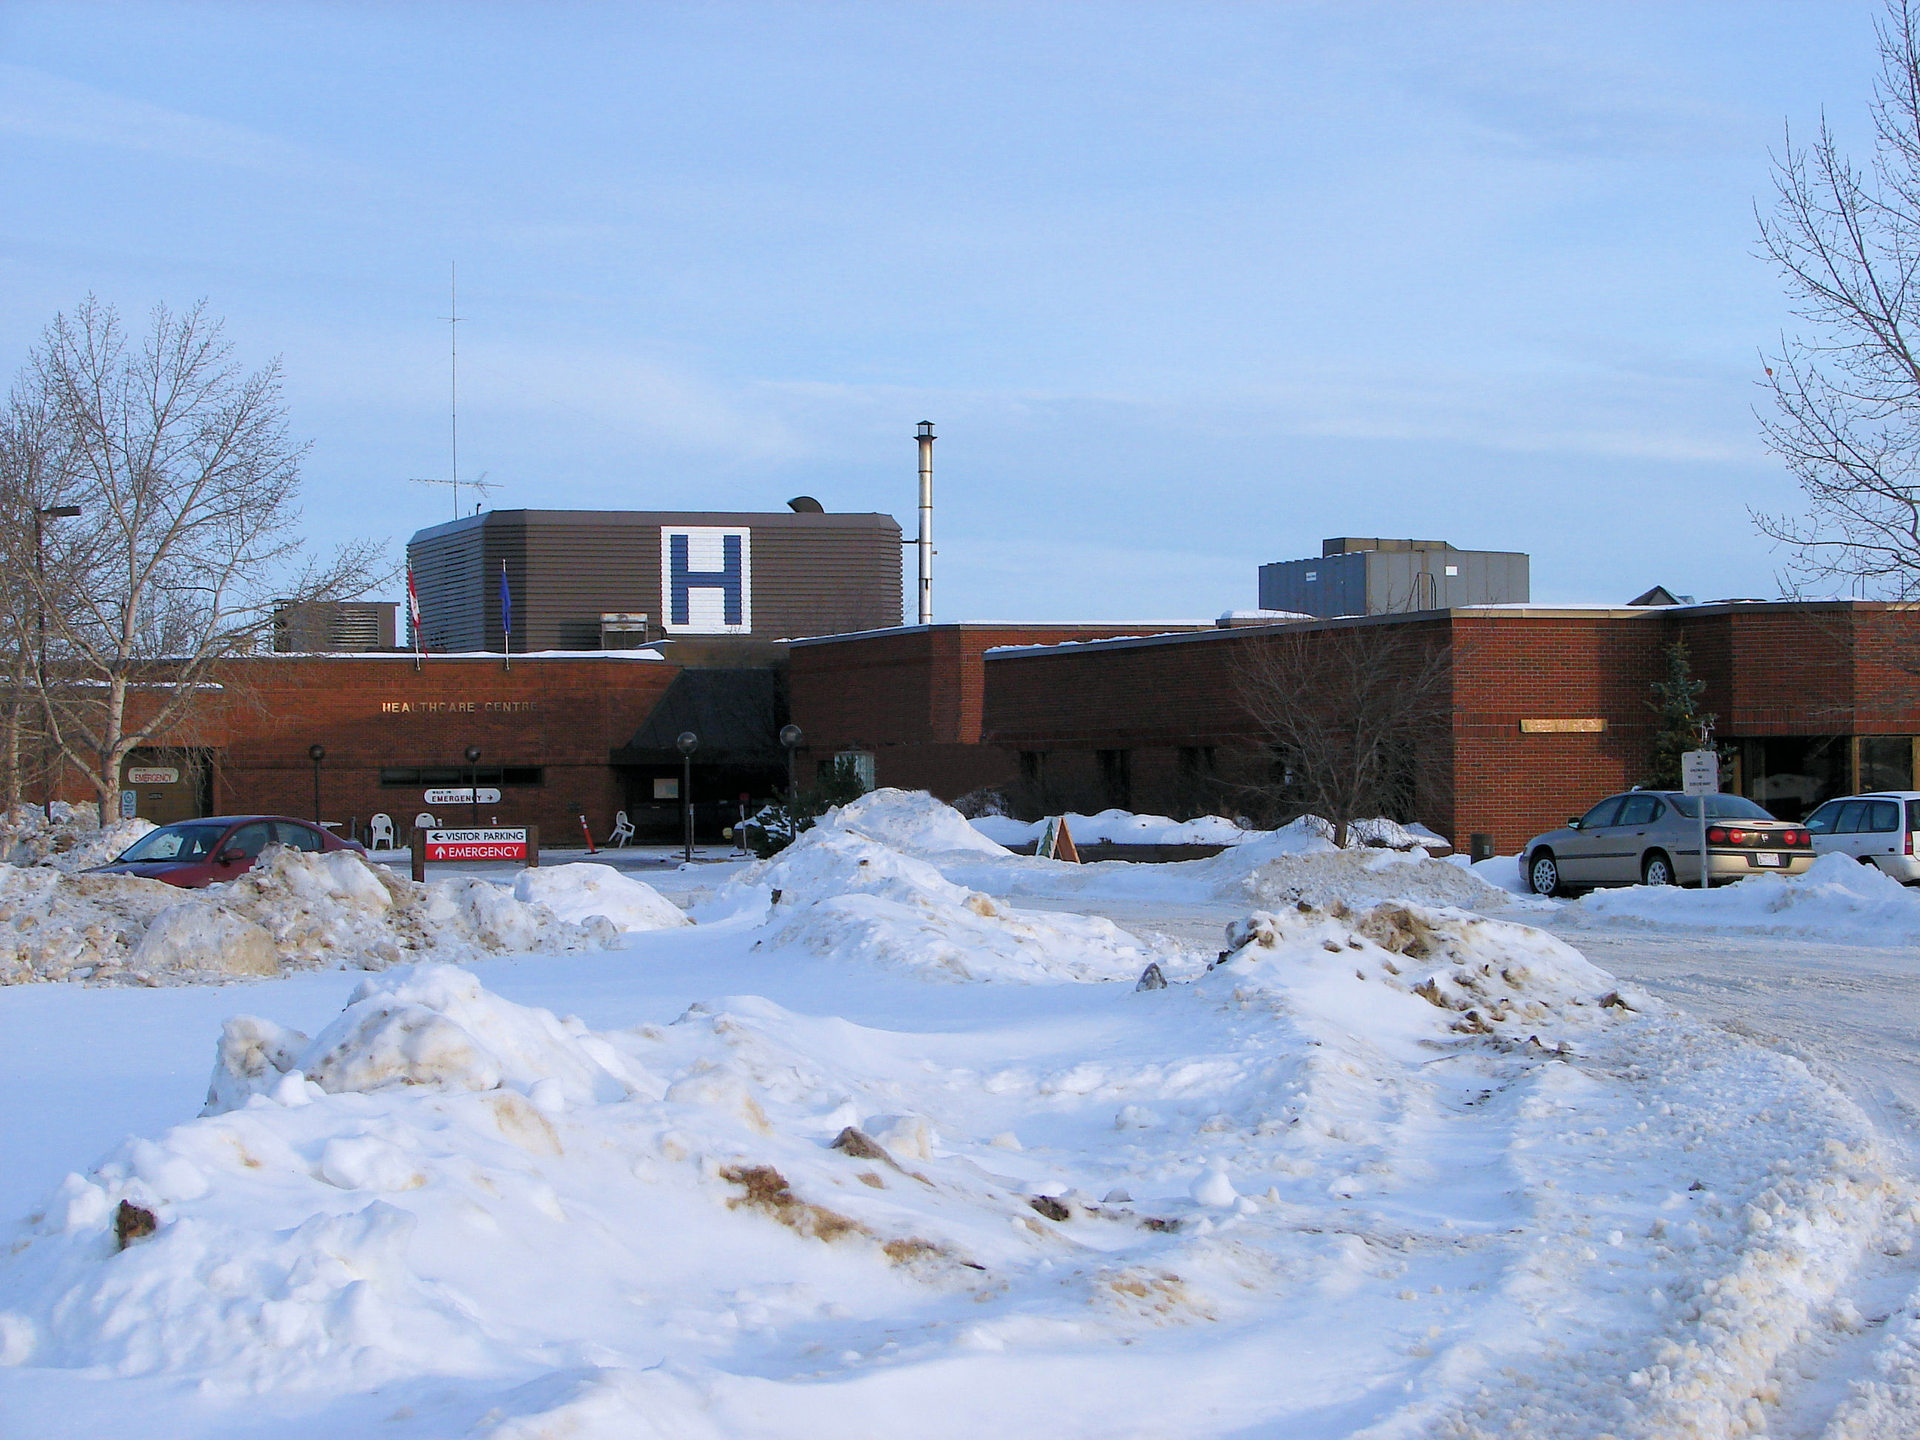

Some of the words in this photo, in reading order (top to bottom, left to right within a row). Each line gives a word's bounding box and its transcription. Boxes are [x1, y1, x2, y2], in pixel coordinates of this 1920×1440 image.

[670, 534, 742, 625] H
[382, 702, 475, 713] HEALTHCARE
[485, 702, 538, 712] CENTRE
[134, 773, 172, 782] EMERGENCY
[446, 832, 480, 841] VISITOR
[484, 831, 524, 841] PARKING
[448, 846, 519, 857] EMERGENCY
